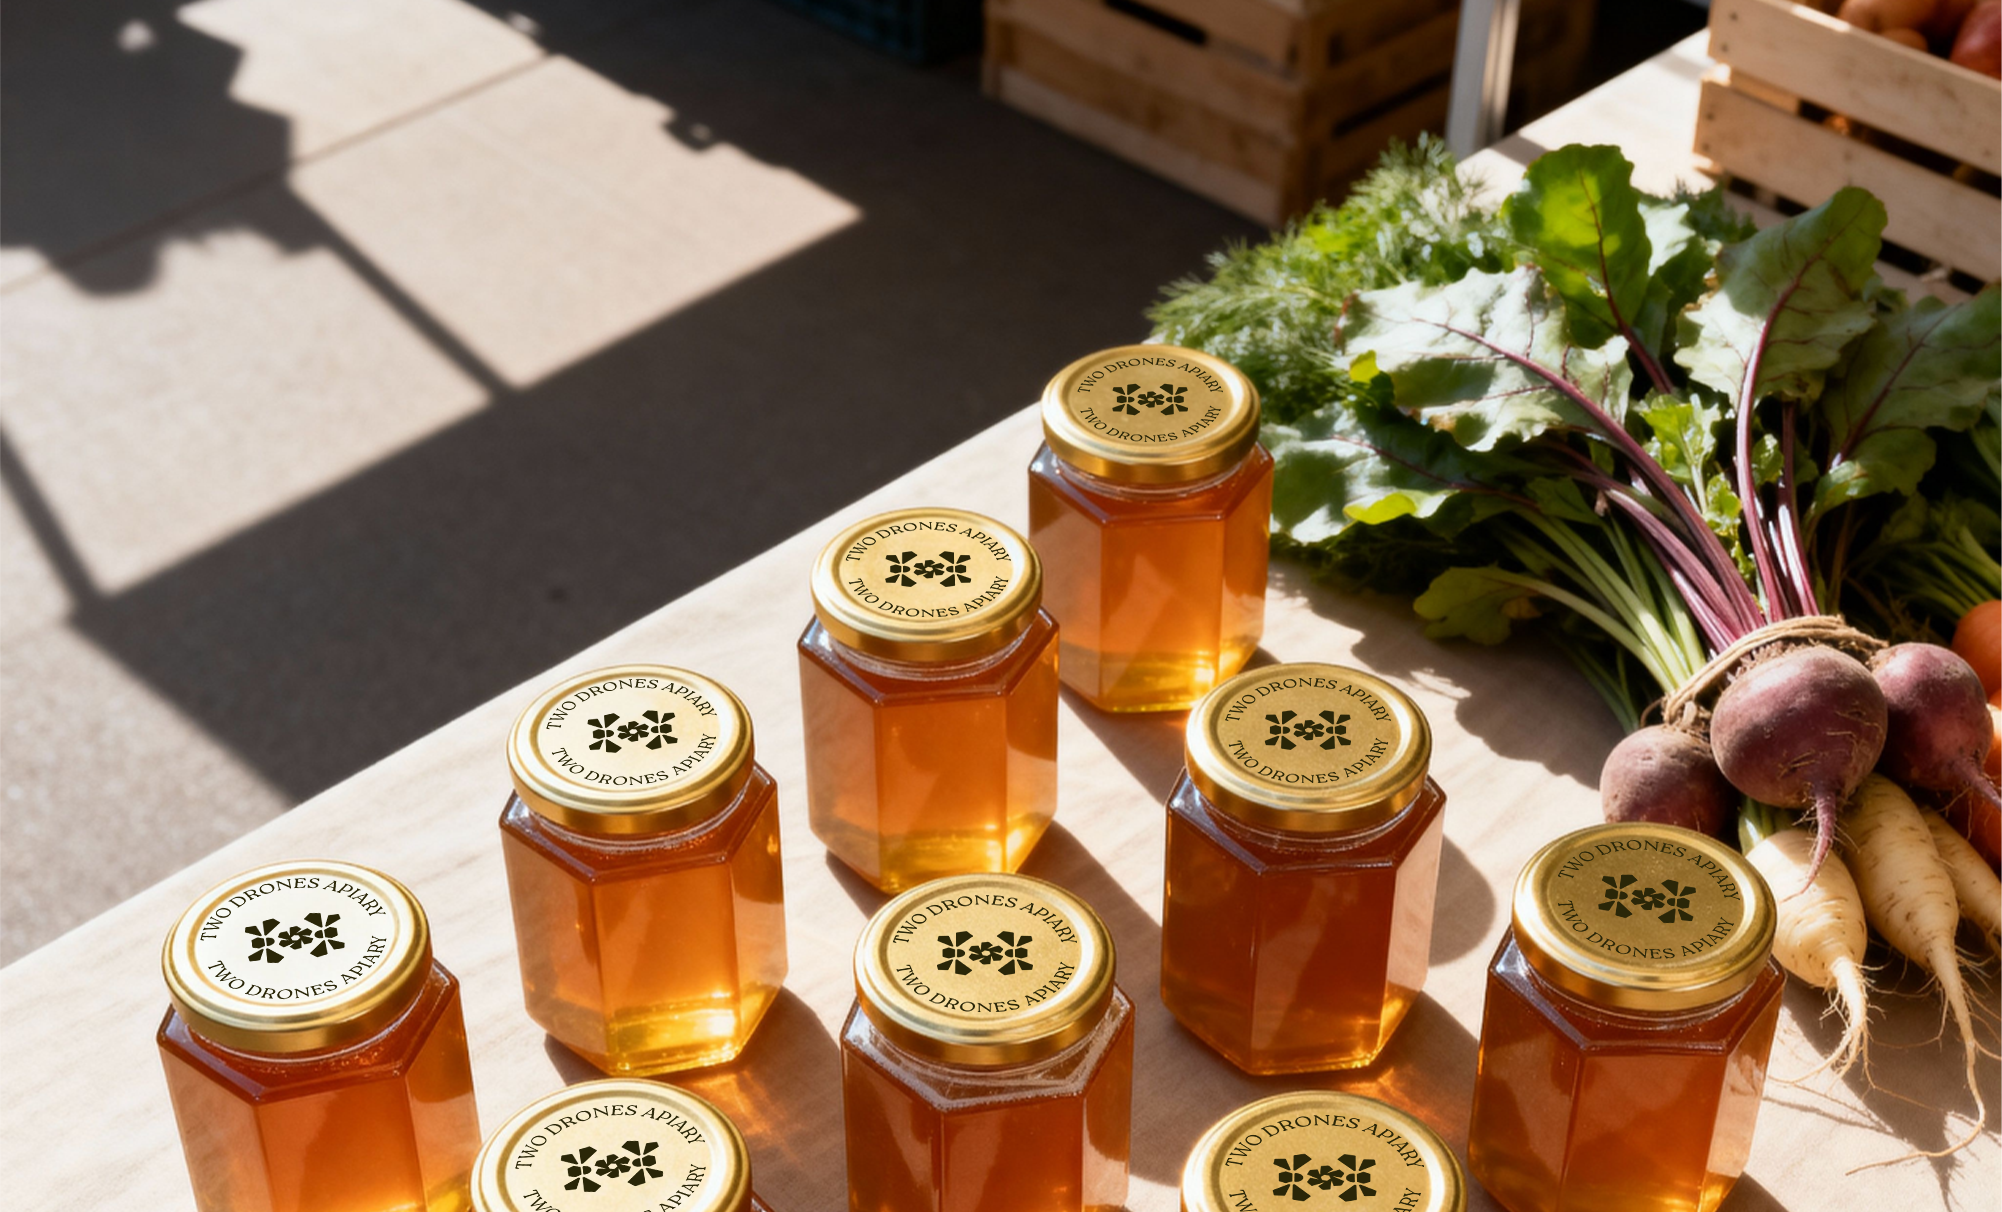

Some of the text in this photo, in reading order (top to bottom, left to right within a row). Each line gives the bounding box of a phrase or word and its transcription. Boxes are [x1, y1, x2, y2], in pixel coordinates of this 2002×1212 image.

[1077, 358, 1223, 394] TWO DRONES APIARY
[1080, 405, 1221, 443] TWO DRONES APIARY
[846, 522, 1011, 562] TWO DRONES APIARY
[849, 576, 1009, 618] TWO DRONES APIARY
[546, 679, 717, 730] TWO DRONES APIARY
[1225, 678, 1391, 722] TWO DRONES APIARY
[552, 733, 716, 785] TWO DRONES APIARY
[1229, 738, 1389, 783] TWO DRONES APIARY
[1558, 839, 1740, 901] TWO DRONES APIARY
[200, 878, 386, 941] TWO DRONES APIARY
[893, 895, 1078, 945] TWO DRONES APIARY
[1558, 900, 1734, 959] TWO DRONES APIARY
[208, 936, 387, 1000] TWO DRONES APIARY
[896, 962, 1075, 1013] TWO DRONES APIARY
[516, 1104, 706, 1170] TWO DRONES APIARY
[1225, 1114, 1425, 1168] TWO DRONES APIARY
[658, 1164, 706, 1212] APIARY
[1229, 1189, 1257, 1212] TW
